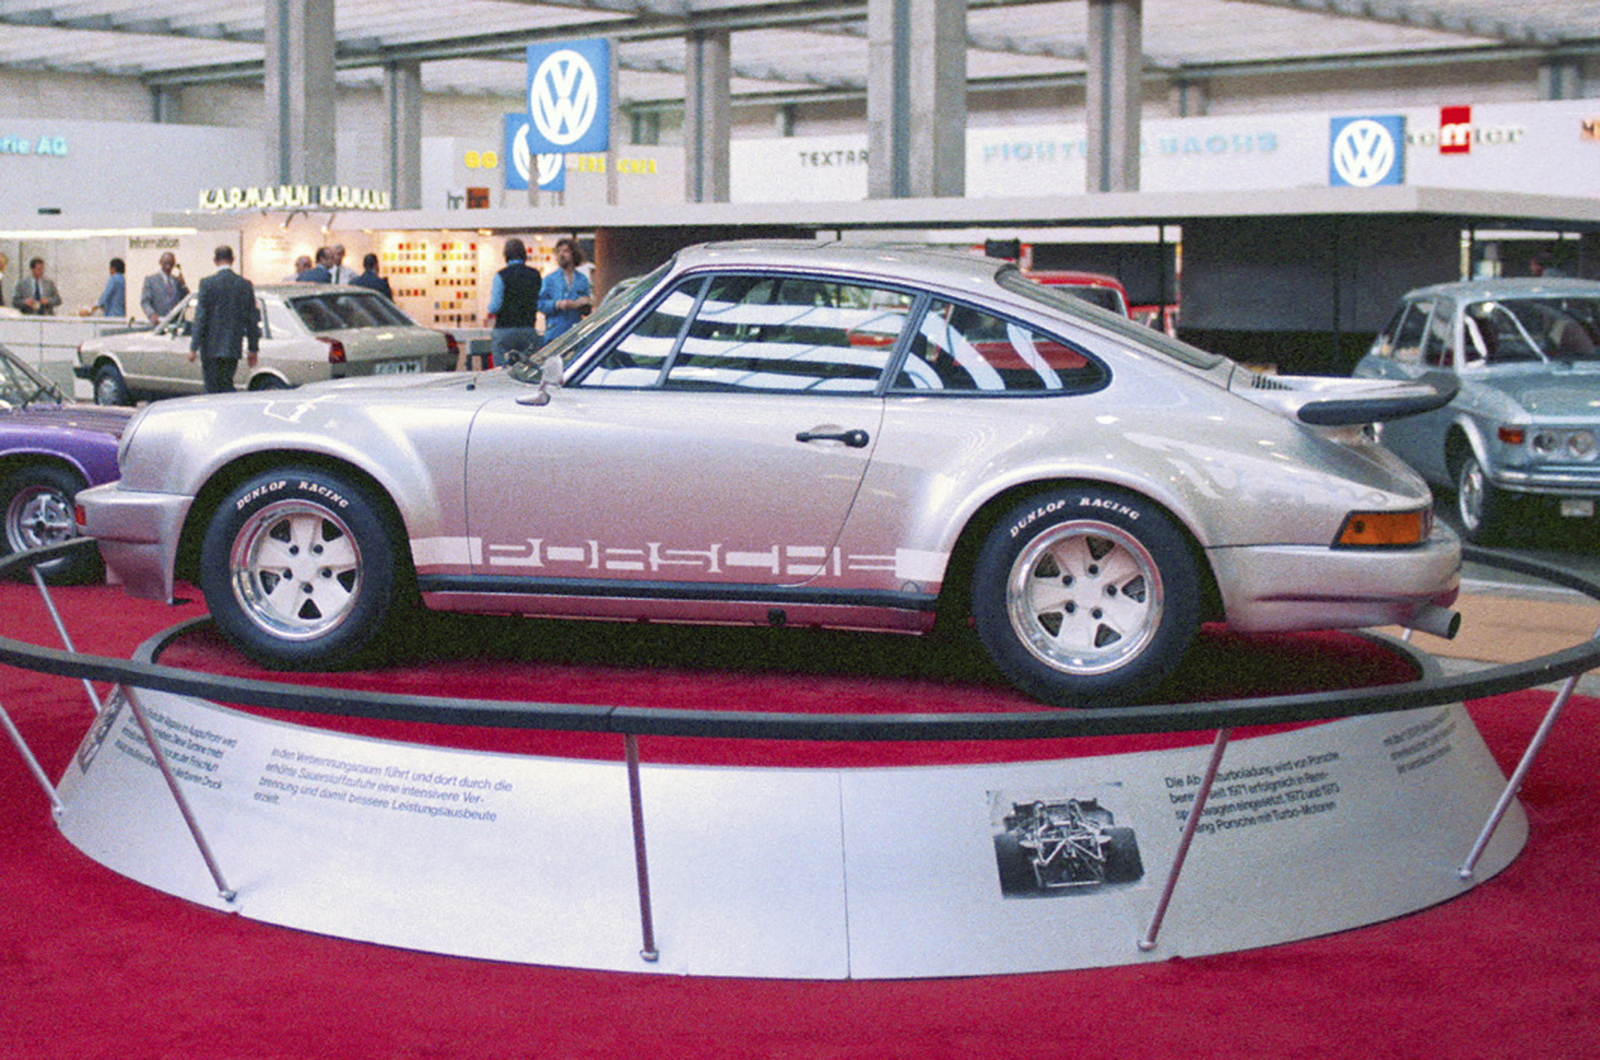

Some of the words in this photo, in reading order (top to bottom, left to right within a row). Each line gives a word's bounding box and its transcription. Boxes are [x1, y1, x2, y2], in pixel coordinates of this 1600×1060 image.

[199, 184, 309, 209] KARMANN
[235, 480, 287, 511] DUNLOP
[298, 481, 349, 508] RACING
[1009, 499, 1066, 537] DUNLOP
[1078, 497, 1141, 520] RACING
[411, 771, 433, 783] und
[433, 773, 458, 786] dort
[459, 776, 492, 790] durch
[493, 779, 514, 792] die
[1165, 776, 1184, 789] Die
[401, 784, 460, 803] intensivere
[348, 792, 390, 808] bessere
[391, 799, 498, 822] Leistungsausbeute
[1215, 816, 1256, 830] Porsche
